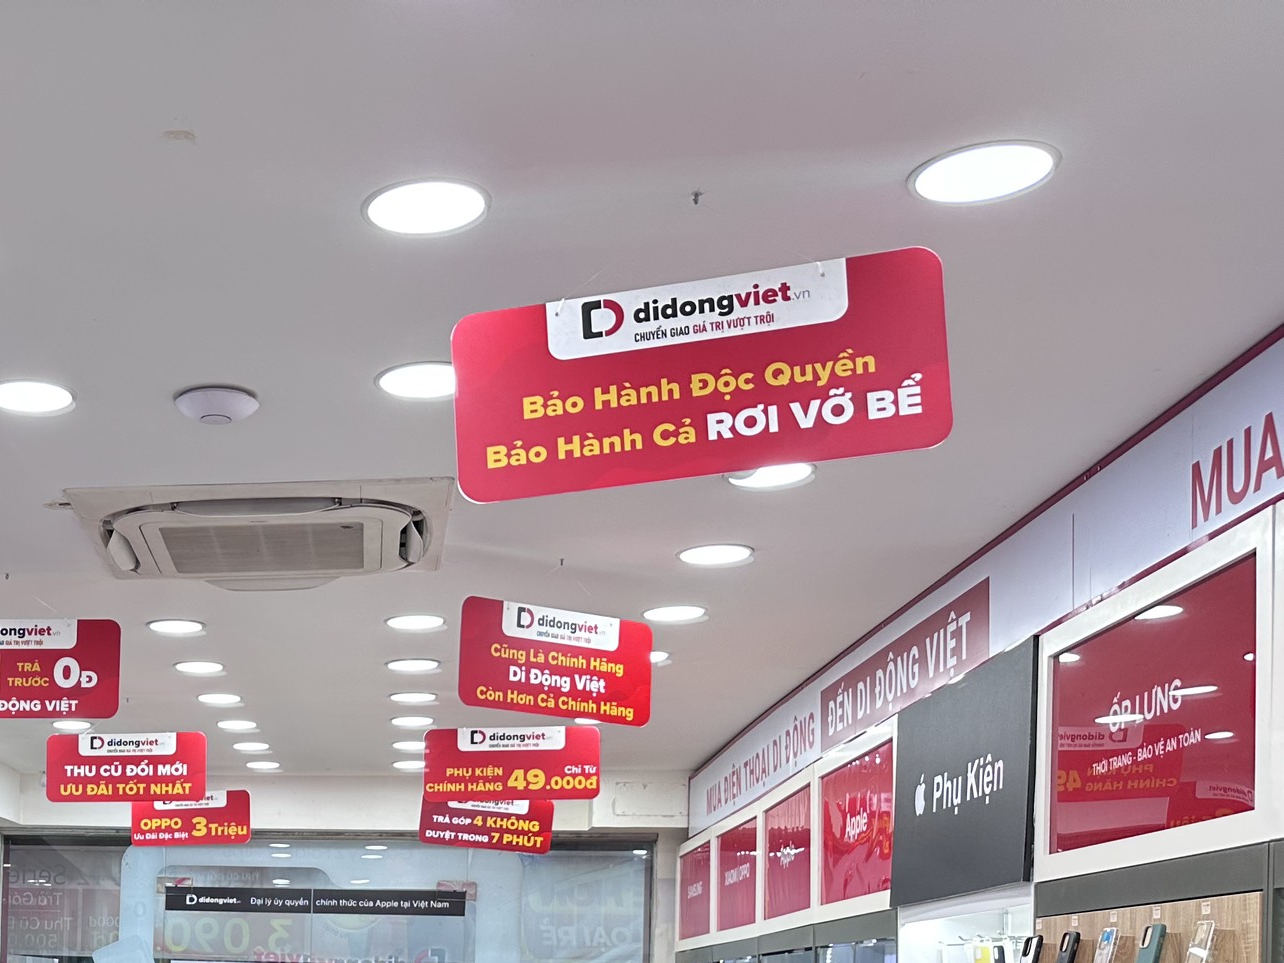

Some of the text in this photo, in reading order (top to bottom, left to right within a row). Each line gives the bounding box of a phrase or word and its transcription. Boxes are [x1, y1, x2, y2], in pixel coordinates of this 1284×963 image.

[634, 311, 775, 343] CHUYỂN GIAO GIÁ TRỊ VƯỢT TRỘI
[522, 348, 877, 420] Bảo Hành Độc Quyền
[486, 372, 924, 469] Bảo Hành Cả RƠI VỠ BỂ
[17, 660, 40, 672] TRẢ
[491, 643, 623, 677] Cũng Là Chính Hãng
[7, 674, 49, 688] TRƯỚC
[509, 666, 605, 697] Di Động Việt
[45, 697, 78, 714] VIỆT
[476, 685, 633, 721] Còn Hơn Cả Chính Hãng
[707, 611, 970, 816] MUA ĐIỆN THOẠI DI ĐỘNG ĐẾN DI ĐỘNG VIỆT
[1092, 728, 1202, 776] THỜI TRANG BẢO VỆ AN TOÀN
[65, 760, 187, 777] THU CŨ ĐỔI MỚI
[446, 765, 503, 779] PHỤ KIỆN
[565, 766, 597, 774] Chỉ Từ
[60, 780, 192, 795] ƯU ĐÃI TỐT NHẤT
[426, 780, 503, 793] CHÍNH HÃNG
[507, 769, 597, 790] 49.000đ
[932, 754, 1004, 815] Phụ Kiện
[140, 817, 247, 839] OPPO 3 Triệu
[433, 814, 540, 831] TRẢ GÓP 4 KHÔNG
[846, 808, 868, 840] Apple
[426, 830, 543, 847] DUYỆT TRONG 7 PHÚT
[250, 897, 263, 907] Đại
[264, 897, 272, 908] lý
[274, 897, 283, 908] ủy
[285, 897, 309, 908] quyền
[316, 898, 338, 907] chính
[340, 898, 357, 907] thức
[359, 898, 374, 907] của
[375, 900, 398, 910] Apple
[400, 900, 411, 909] tại
[413, 900, 428, 909] Việt
[430, 900, 449, 908] Nam
